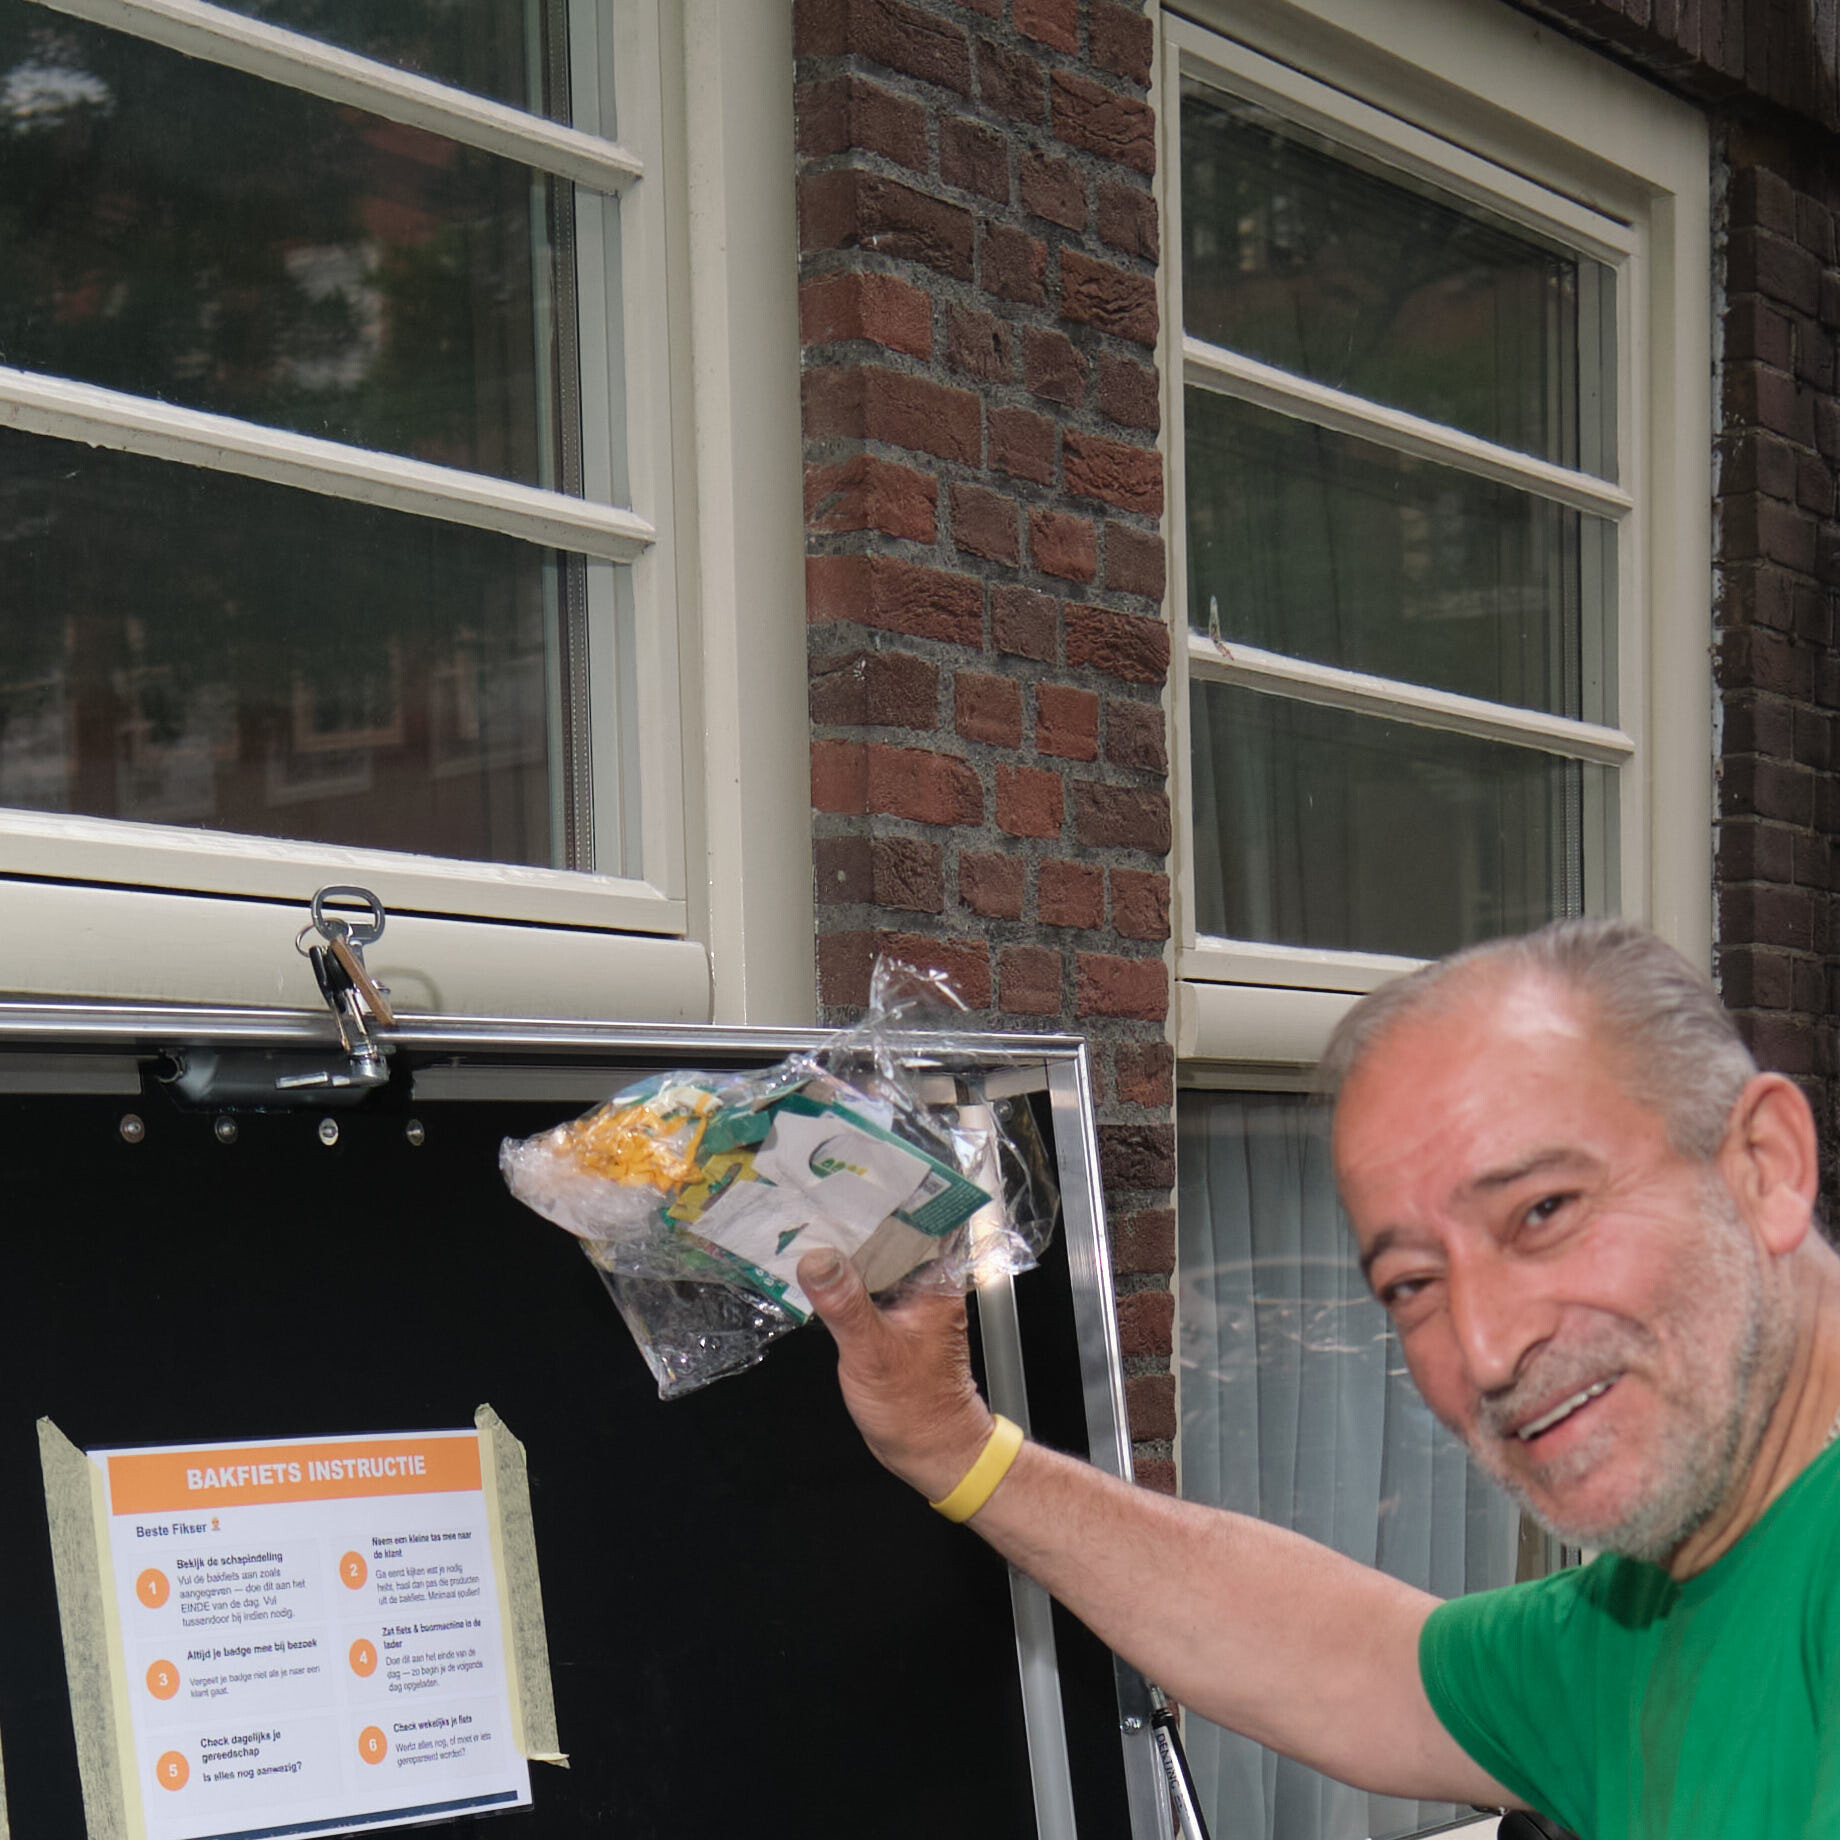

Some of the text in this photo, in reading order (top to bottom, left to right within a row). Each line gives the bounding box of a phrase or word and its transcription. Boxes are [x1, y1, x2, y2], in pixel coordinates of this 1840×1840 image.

[186, 1455, 426, 1490] BAKFIETS INSTRUCTIE
[136, 1523, 206, 1538] Beste Fikser
[349, 1563, 358, 1577] 2
[148, 1581, 157, 1594] 1
[359, 1651, 368, 1664] 4
[158, 1672, 169, 1686] 3
[200, 1730, 281, 1749] Check dagelijks je
[368, 1738, 378, 1751] 6
[202, 1748, 260, 1764] gereedschap
[168, 1763, 178, 1777] 5
